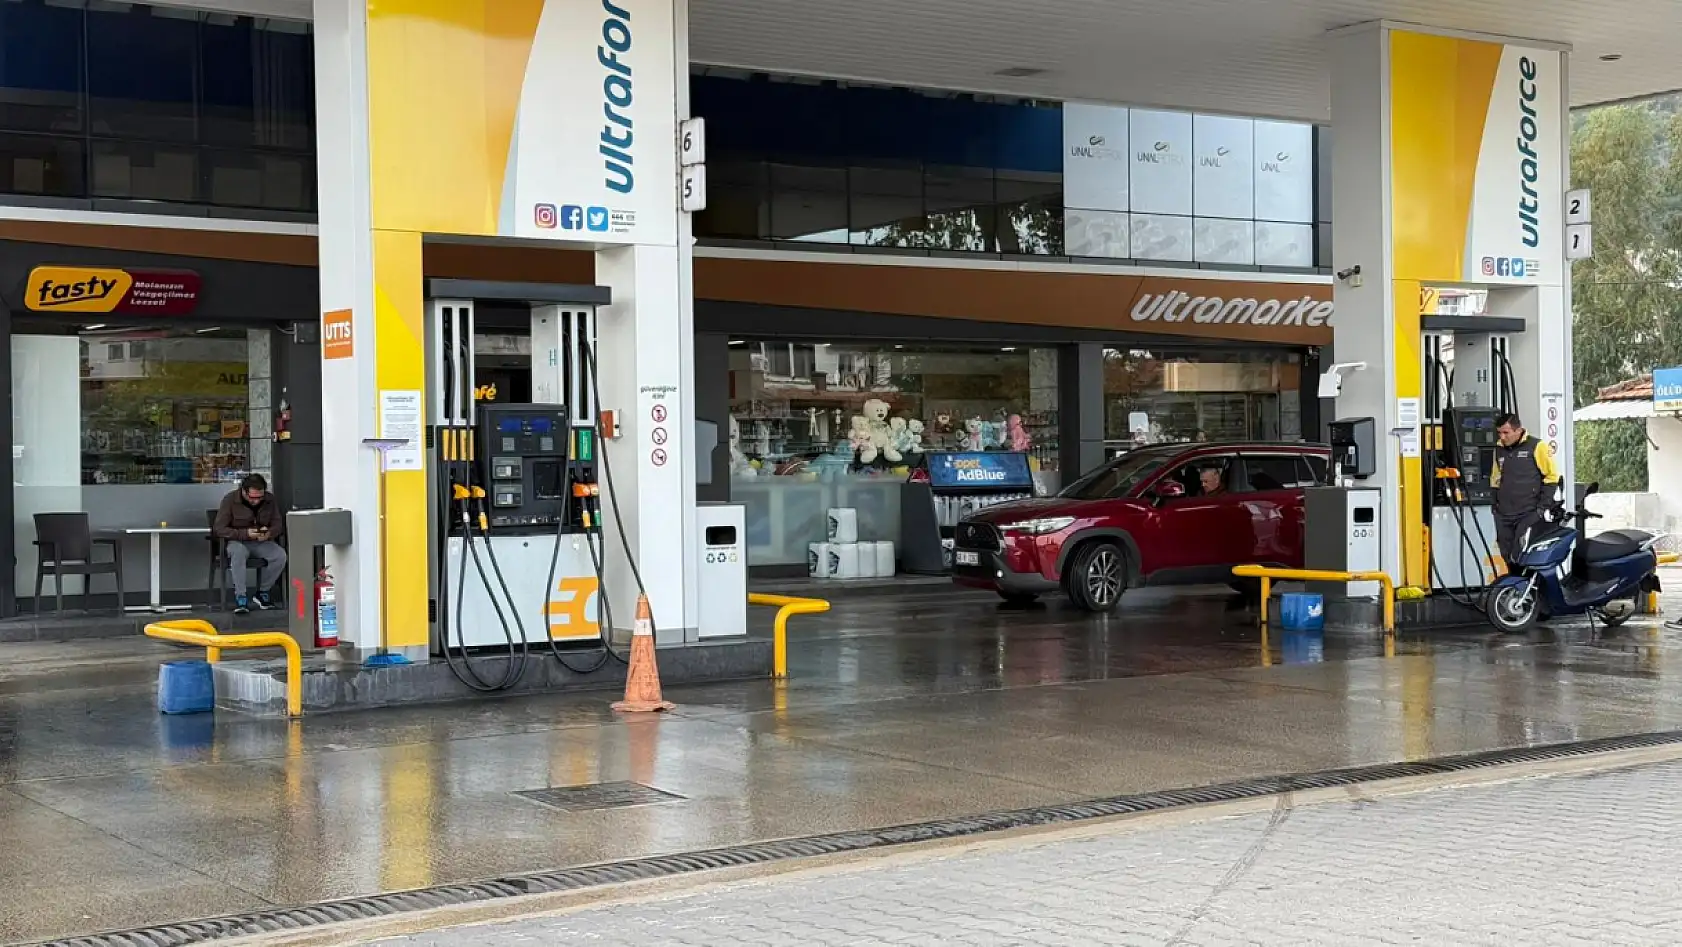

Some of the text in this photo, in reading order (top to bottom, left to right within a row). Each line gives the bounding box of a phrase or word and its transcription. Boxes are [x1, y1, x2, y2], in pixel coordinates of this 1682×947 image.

[683, 131, 692, 152] 6
[1516, 56, 1539, 249] ultraforce
[683, 177, 692, 198] 5
[1569, 200, 1580, 215] 2
[1572, 235, 1580, 249] 1
[38, 275, 118, 303] fasty
[1130, 290, 1334, 327] ultramarke
[325, 321, 351, 341] UTTS
